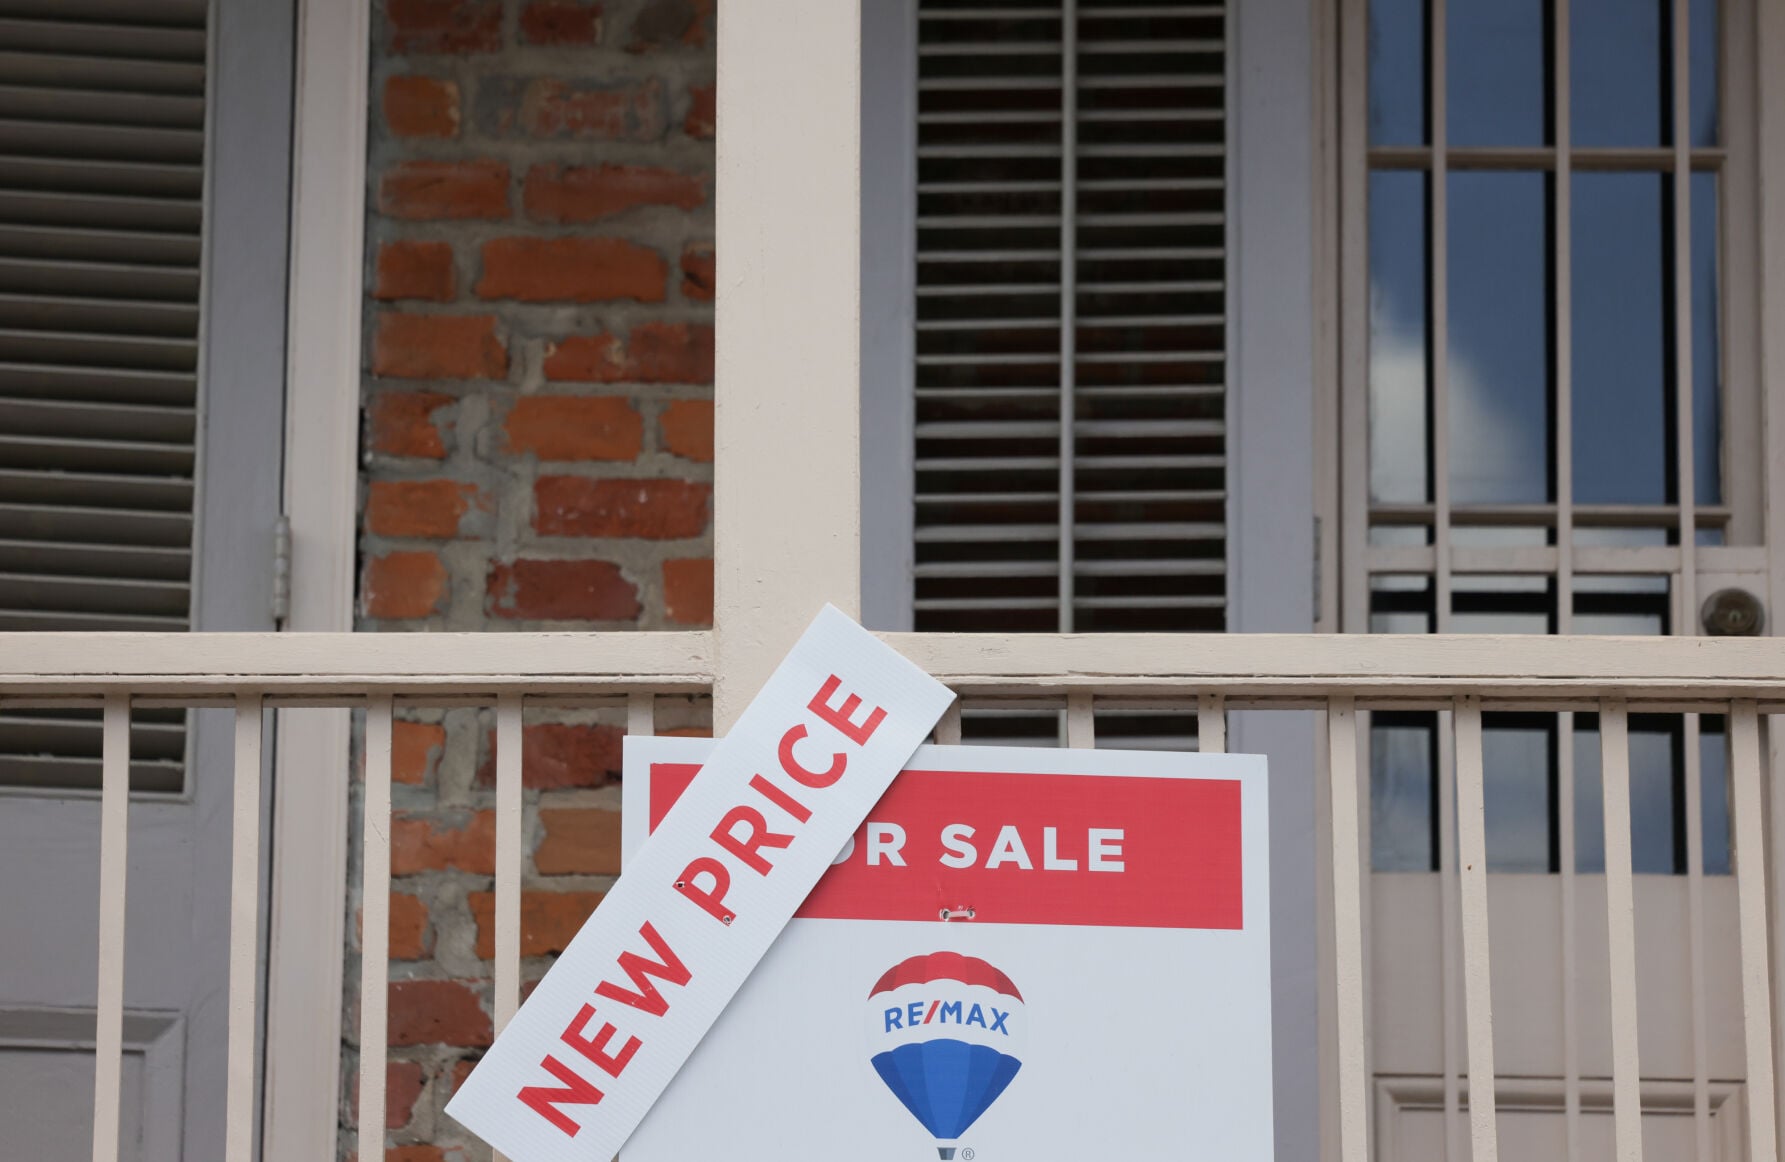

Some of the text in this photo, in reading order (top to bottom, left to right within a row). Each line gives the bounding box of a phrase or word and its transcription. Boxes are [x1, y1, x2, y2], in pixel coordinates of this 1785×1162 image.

[938, 823, 1126, 873] SALE
[516, 673, 888, 1138] NEW PRICE
[884, 1000, 1010, 1036] RE/MAX
